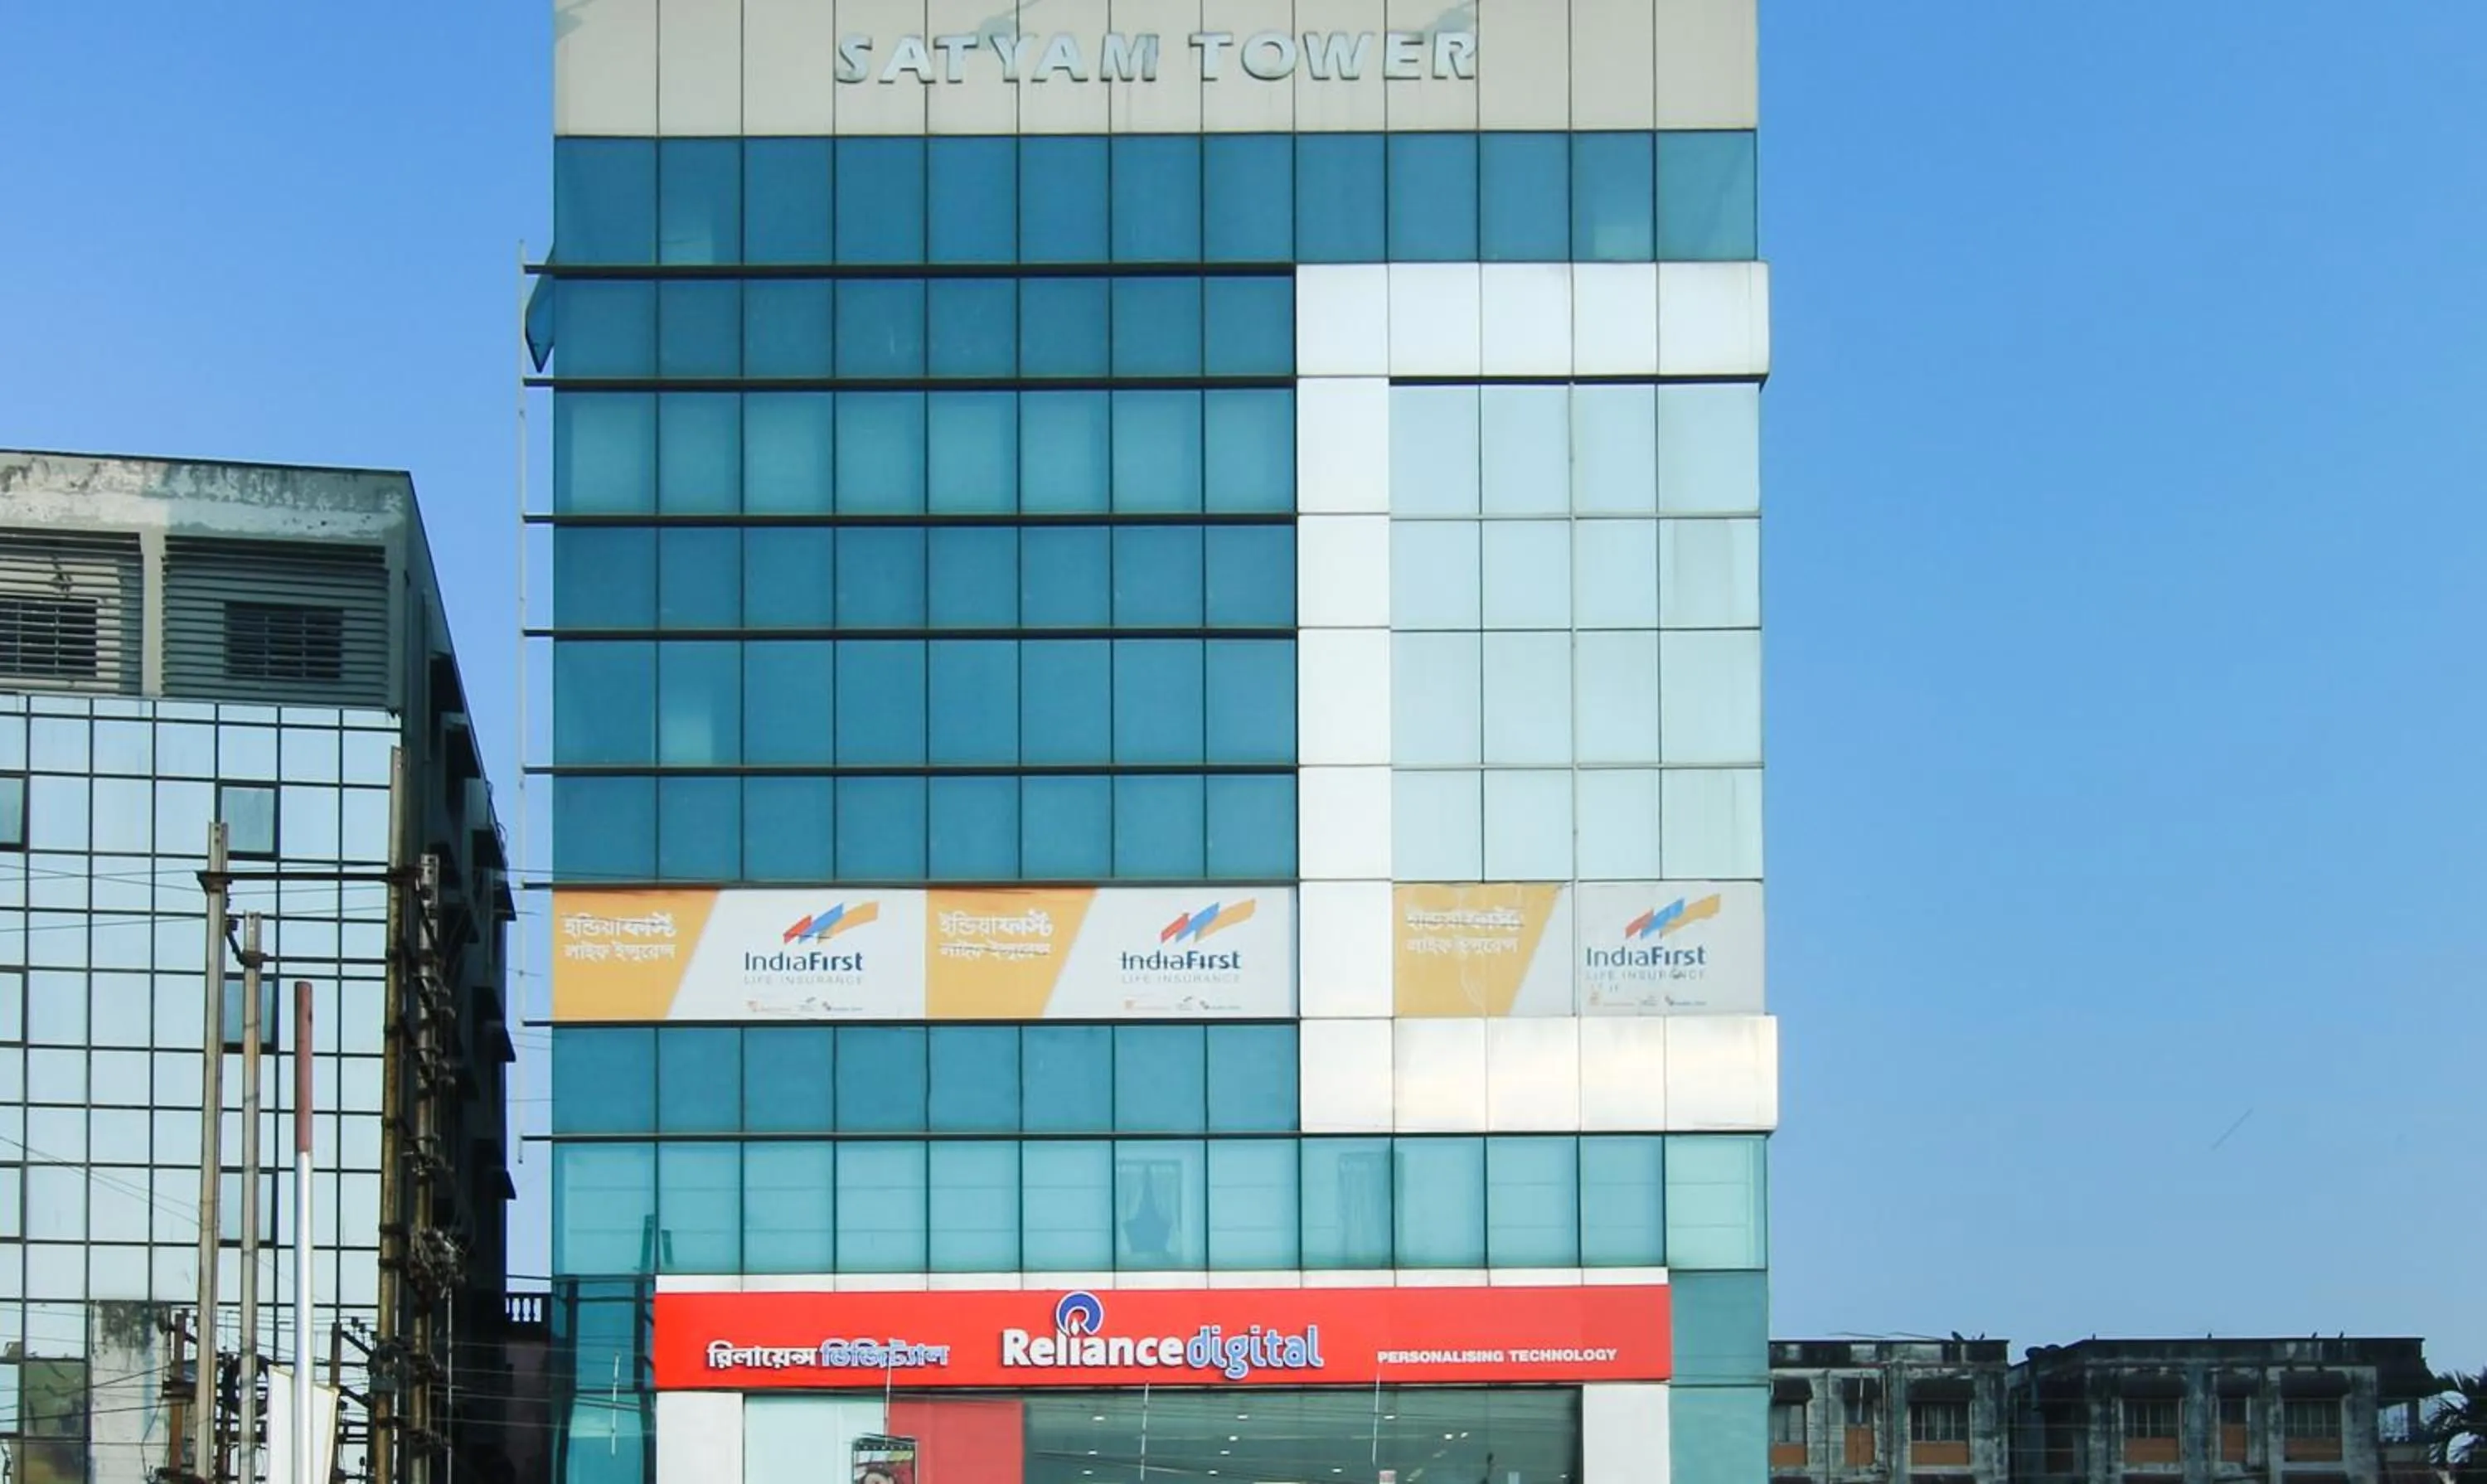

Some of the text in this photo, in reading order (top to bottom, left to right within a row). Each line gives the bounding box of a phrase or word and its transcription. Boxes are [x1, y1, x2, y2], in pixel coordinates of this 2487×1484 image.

[835, 31, 1477, 84] SATYAM TOWER
[744, 951, 863, 971] IndiaFirst
[1121, 950, 1242, 970] IndiaFirst
[1587, 946, 1706, 967] IndiaFirst
[1377, 1348, 1617, 1364] PERSONALISING TECHNOLOGY
